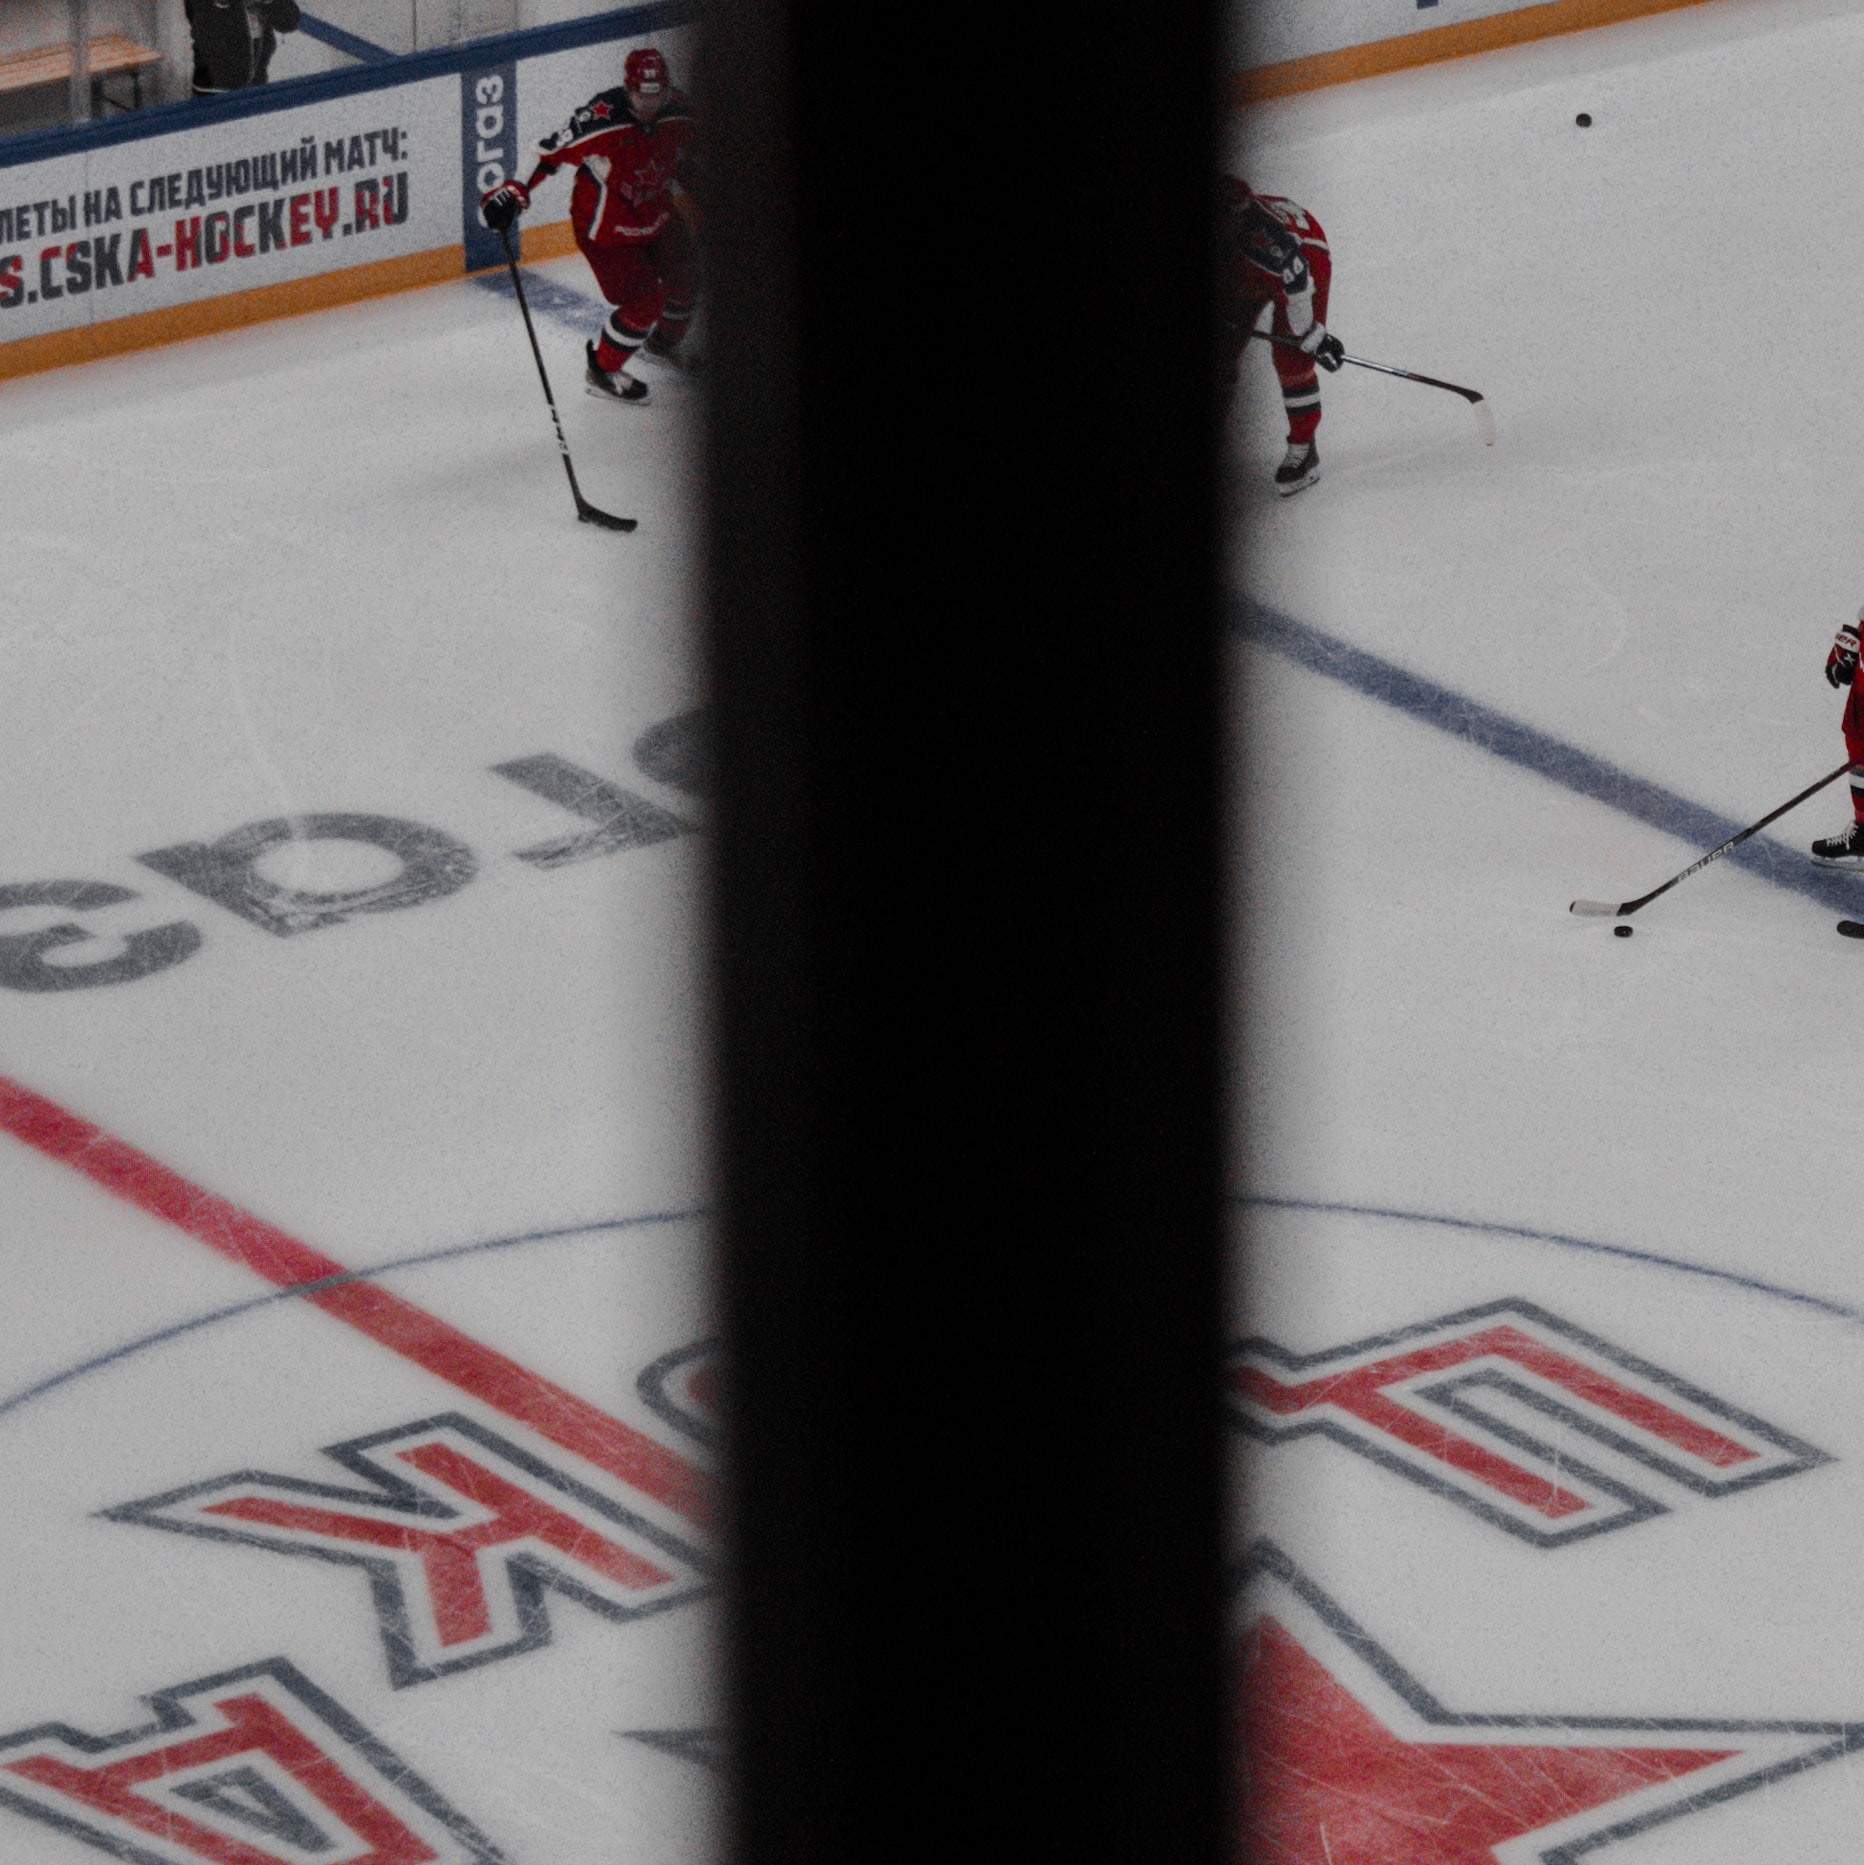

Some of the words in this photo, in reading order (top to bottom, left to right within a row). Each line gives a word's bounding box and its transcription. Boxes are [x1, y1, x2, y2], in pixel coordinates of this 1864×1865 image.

[83, 184, 123, 227] НА
[129, 135, 318, 216] СЛЕДУЮЩИЙ
[323, 125, 408, 176] МАТЧ:
[474, 73, 505, 228] огаз
